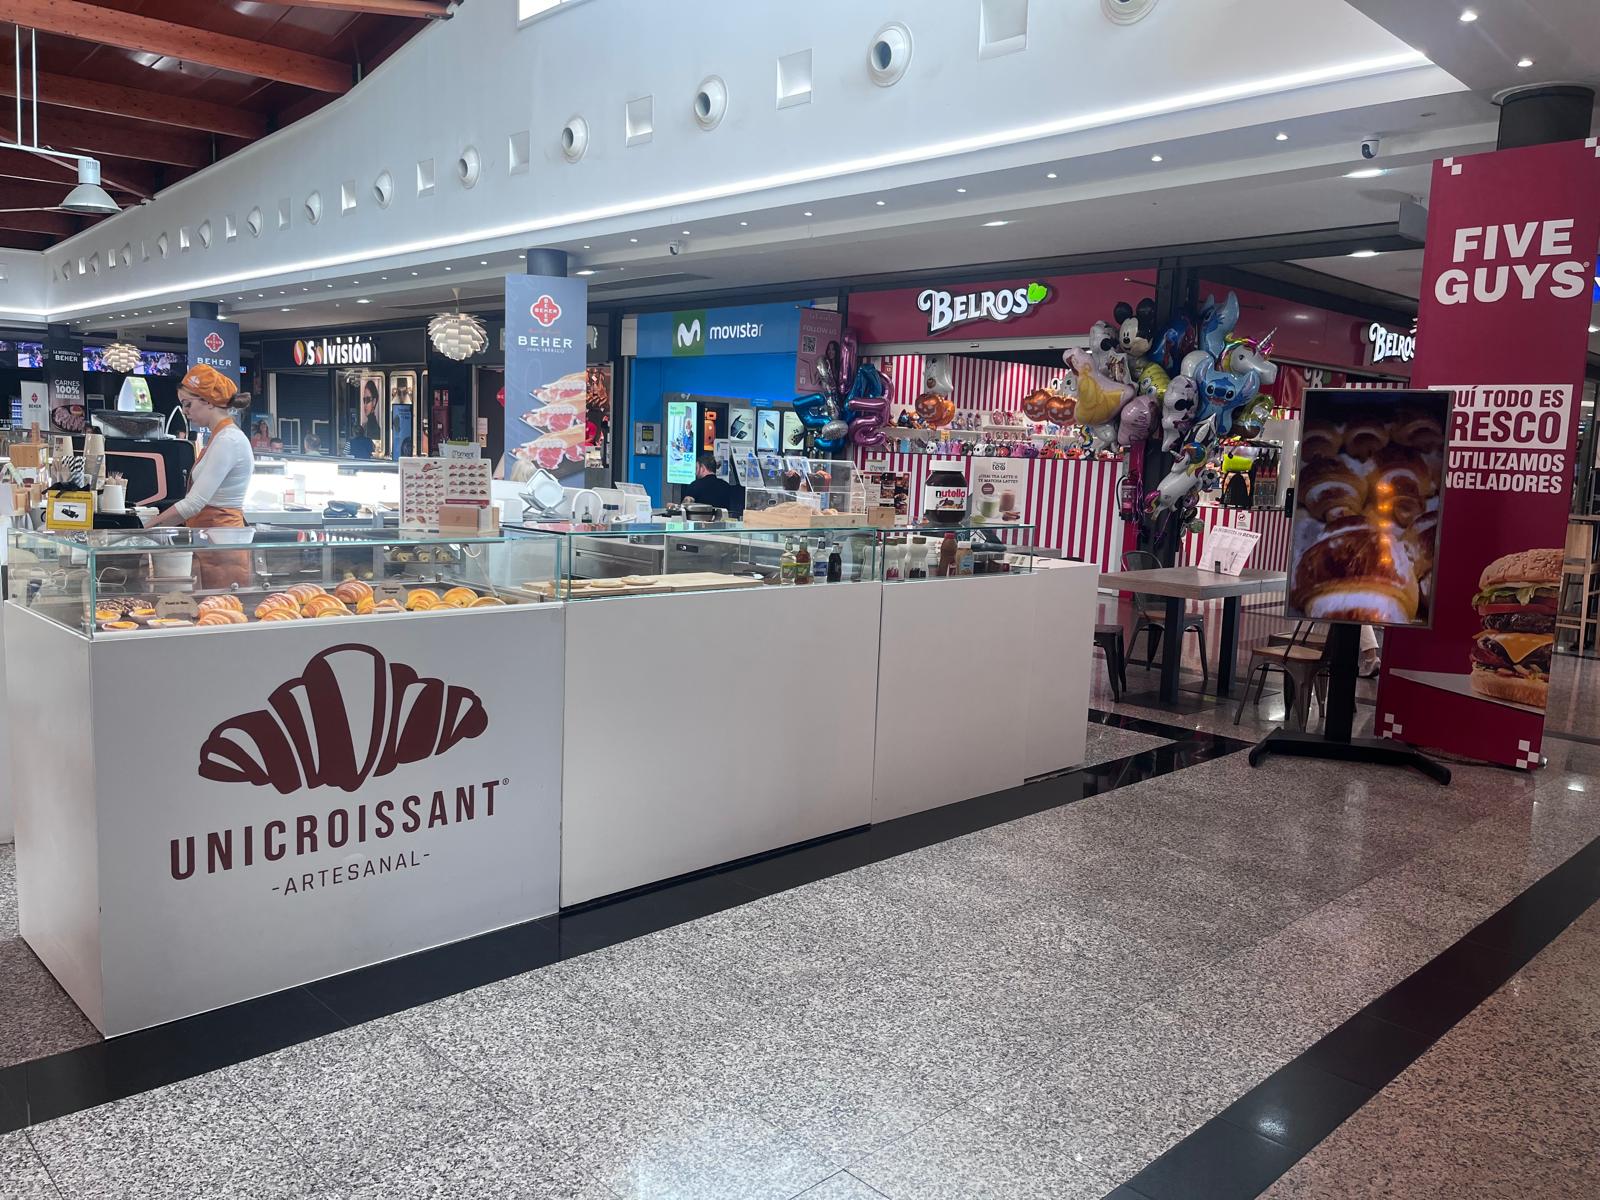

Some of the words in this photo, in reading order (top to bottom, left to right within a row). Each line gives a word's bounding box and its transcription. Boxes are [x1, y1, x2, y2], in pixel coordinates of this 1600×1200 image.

[1452, 218, 1575, 263] FIVE
[1434, 261, 1585, 305] GUYS
[917, 289, 1029, 332] BELROS
[709, 322, 764, 340] movistar
[802, 325, 828, 334] FOLLOW
[306, 336, 372, 365] Solvisión
[518, 335, 573, 349] BEHER
[55, 354, 78, 362] BEHER
[197, 357, 232, 367] BEHER
[55, 386, 80, 394] 100%
[1482, 389, 1533, 408] TODO
[1539, 389, 1564, 408] ES
[1450, 410, 1562, 444] RESCO
[1449, 451, 1565, 473] UTILIZAMOS
[1446, 471, 1563, 494] NGELADORES
[935, 489, 966, 498] nutella
[170, 780, 500, 880] UNICROISSANT
